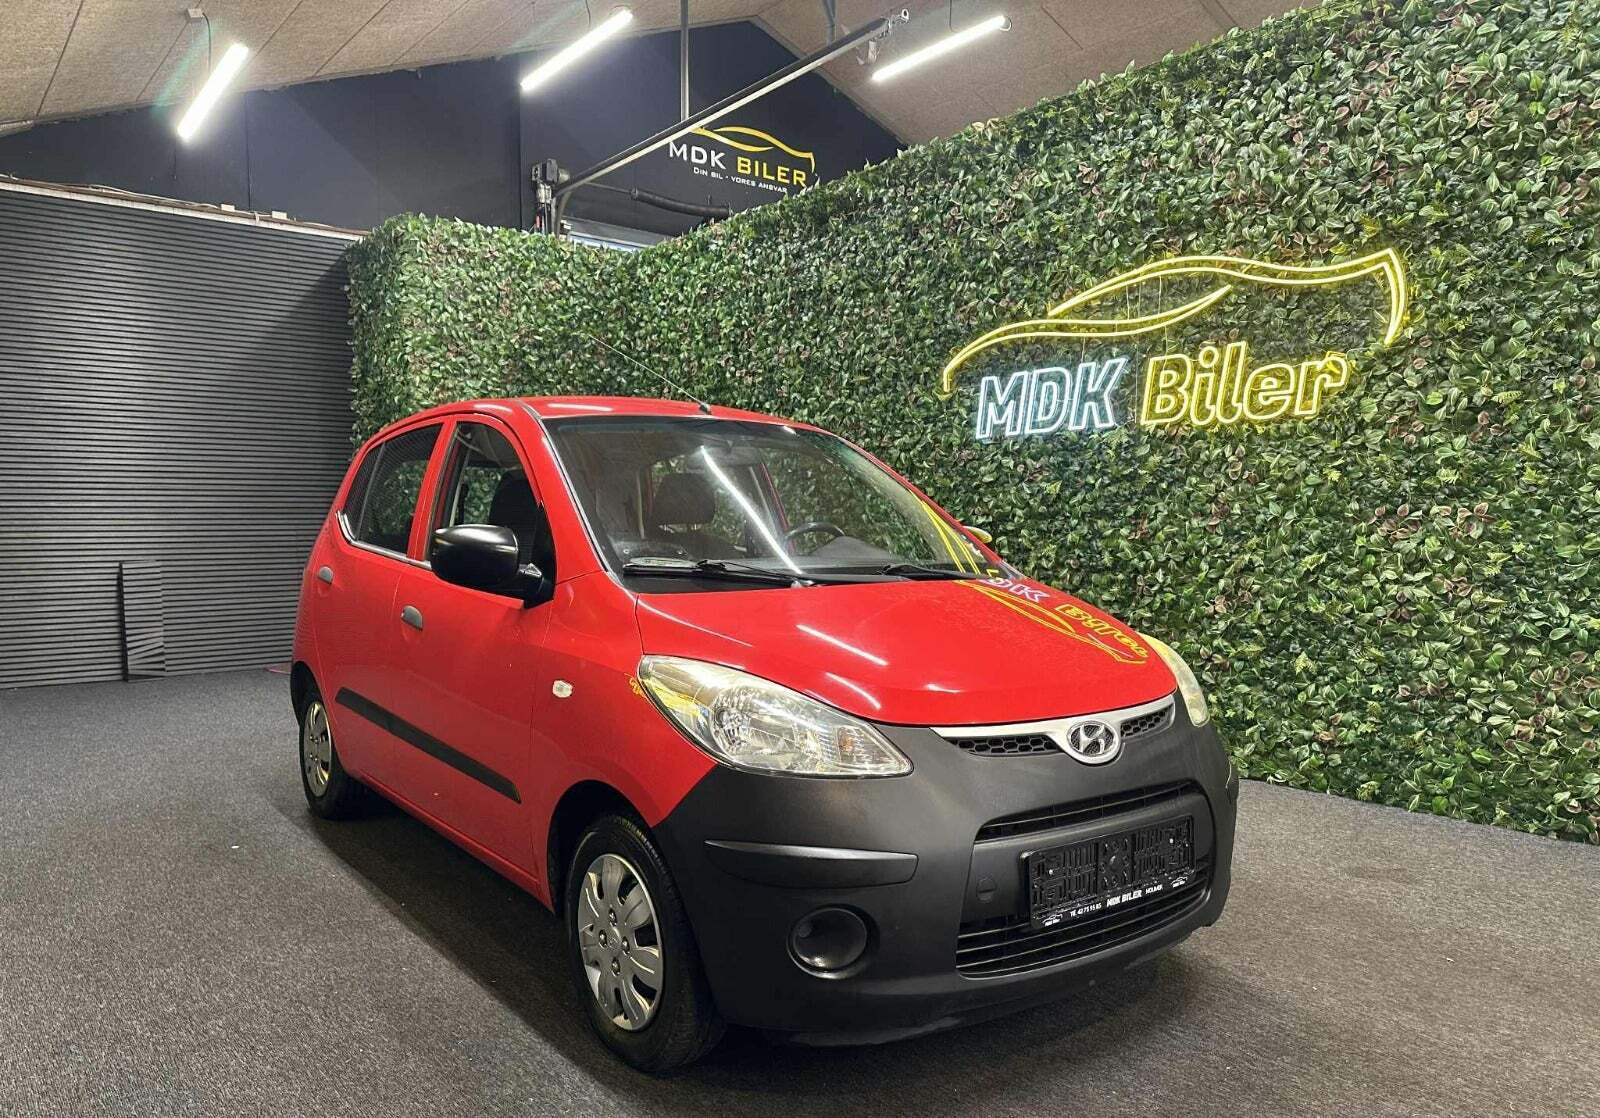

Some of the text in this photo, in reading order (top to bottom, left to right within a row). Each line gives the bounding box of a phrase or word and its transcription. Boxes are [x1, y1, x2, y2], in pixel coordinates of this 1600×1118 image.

[669, 141, 807, 188] MDK BILER
[710, 171, 724, 180] BIL
[731, 175, 756, 187] VORES
[758, 182, 788, 194] ANSVAR
[975, 340, 1352, 442] MDK Biler
[1122, 890, 1142, 902] BILER
